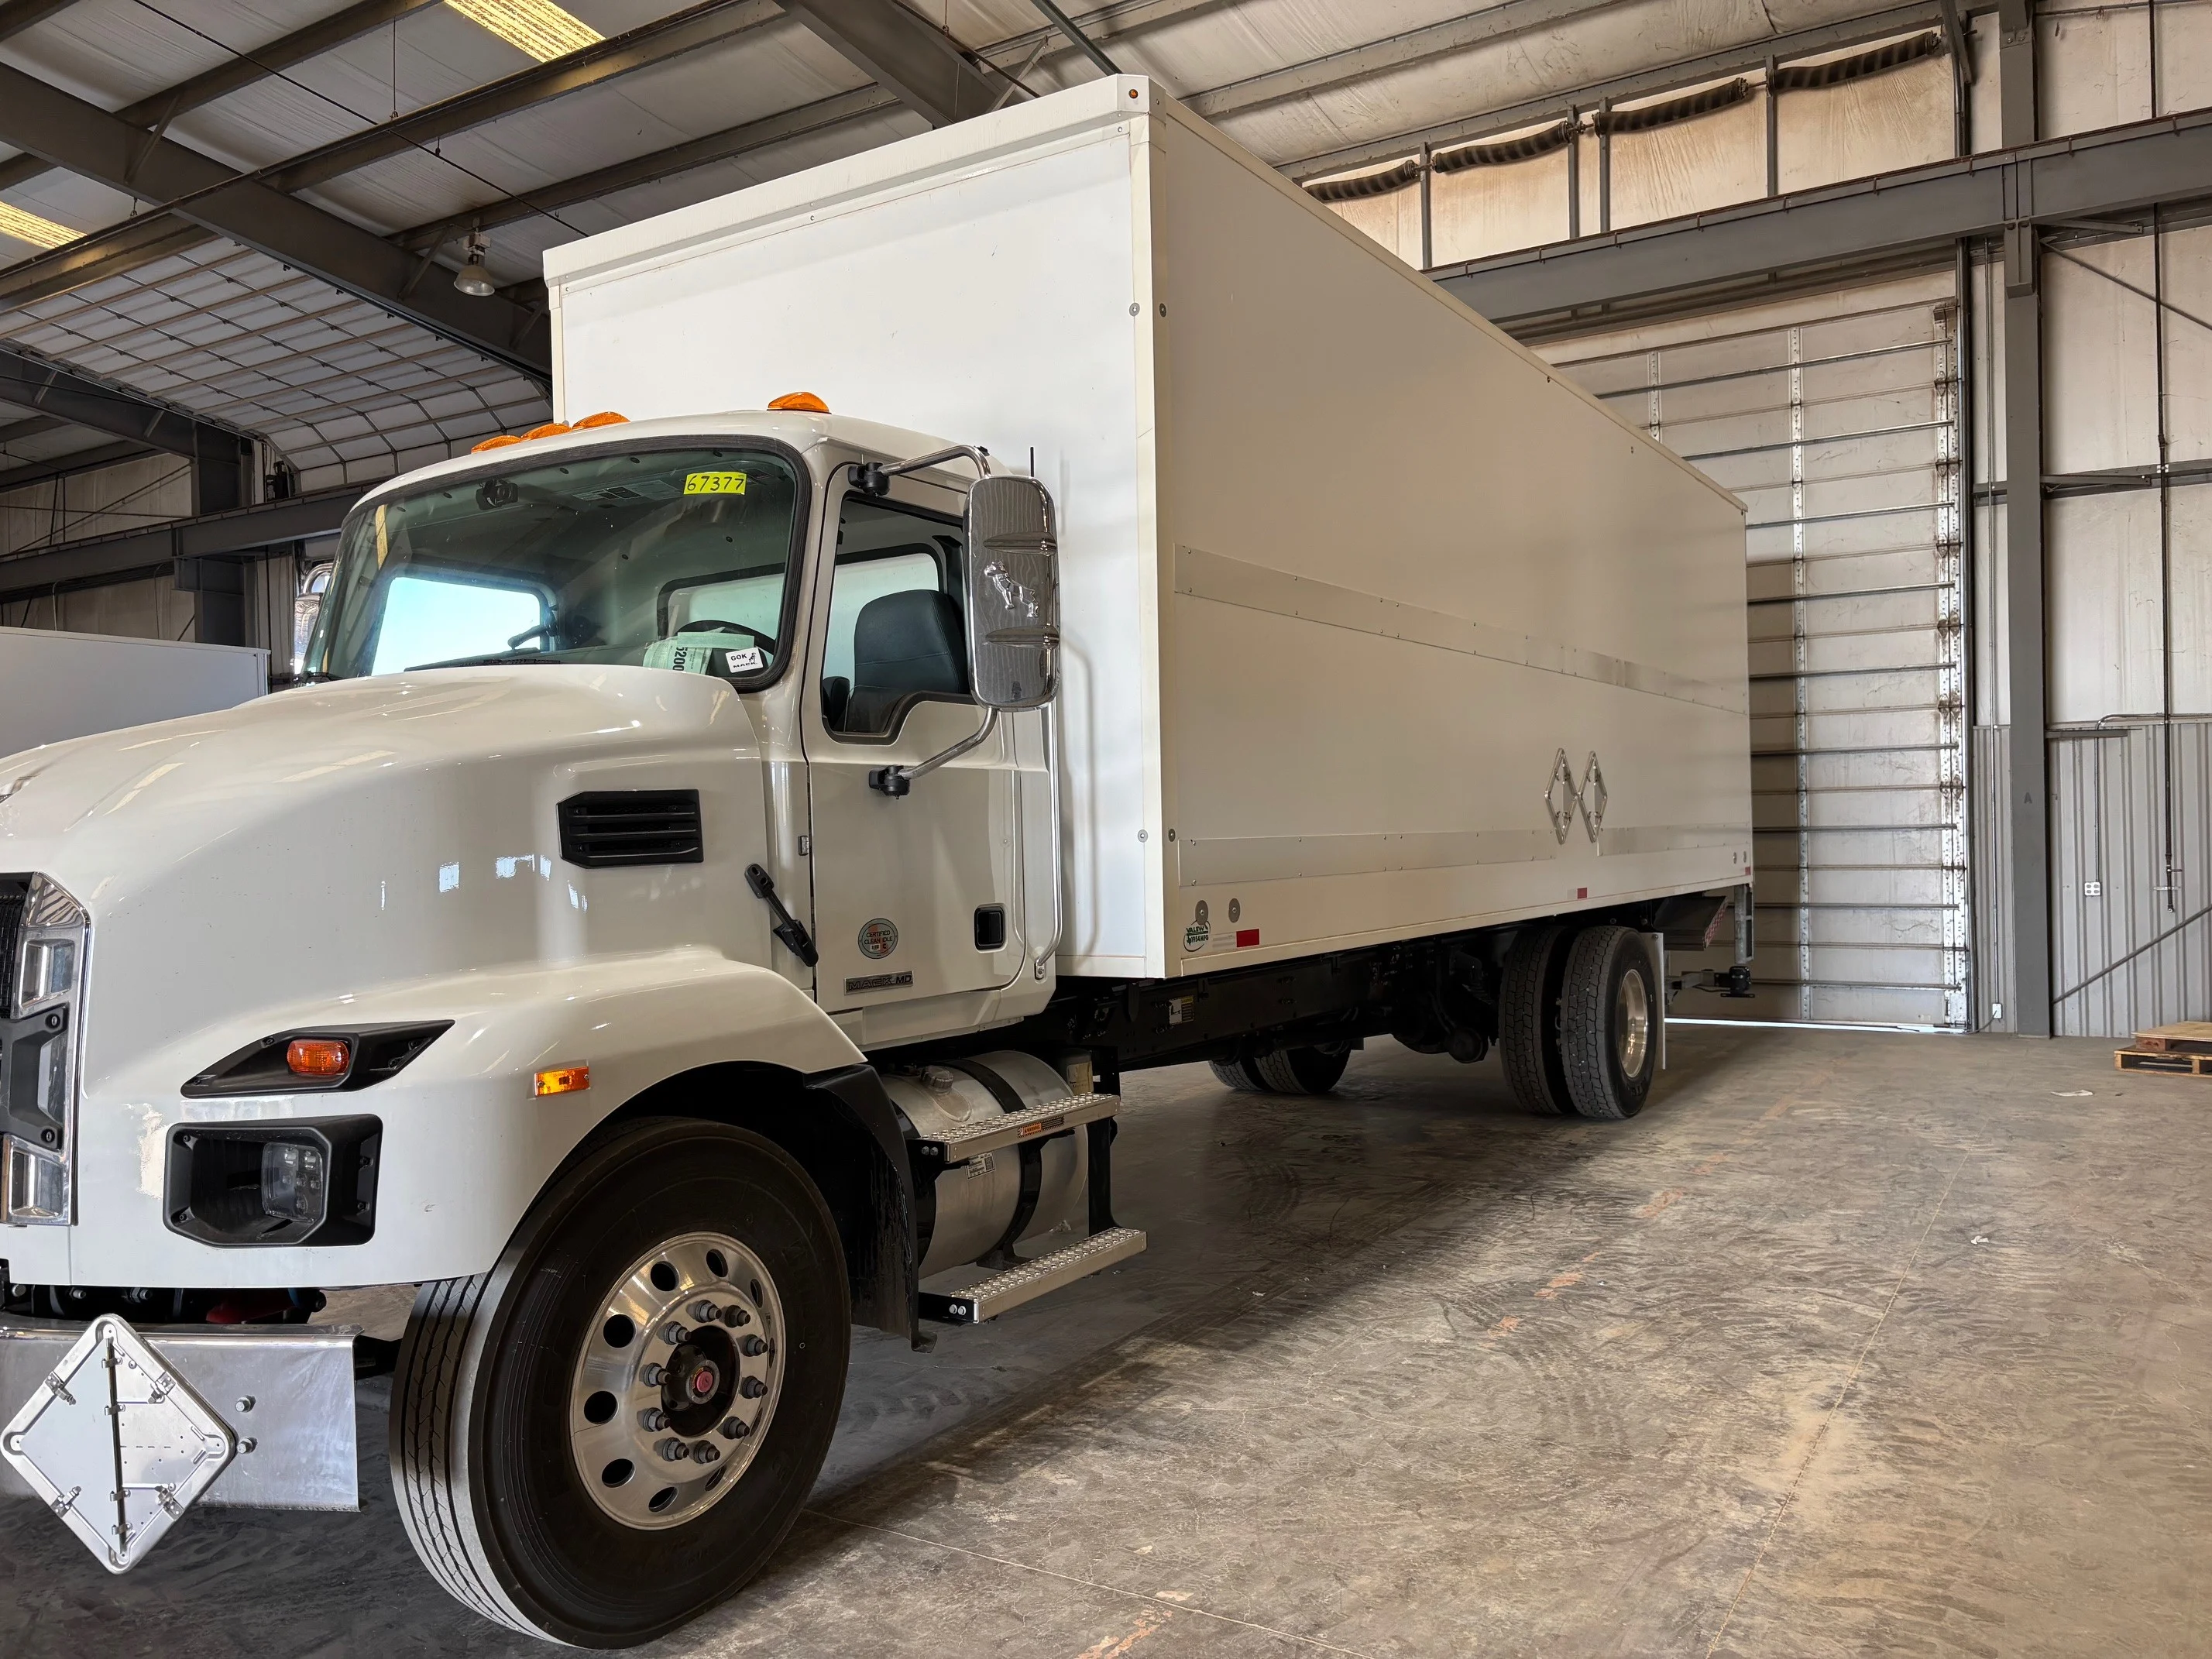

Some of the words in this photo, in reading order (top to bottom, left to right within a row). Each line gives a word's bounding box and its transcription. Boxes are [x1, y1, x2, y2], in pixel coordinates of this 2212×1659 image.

[687, 475, 744, 492] 67377
[849, 977, 891, 990] MACK
[895, 974, 912, 984] MD
